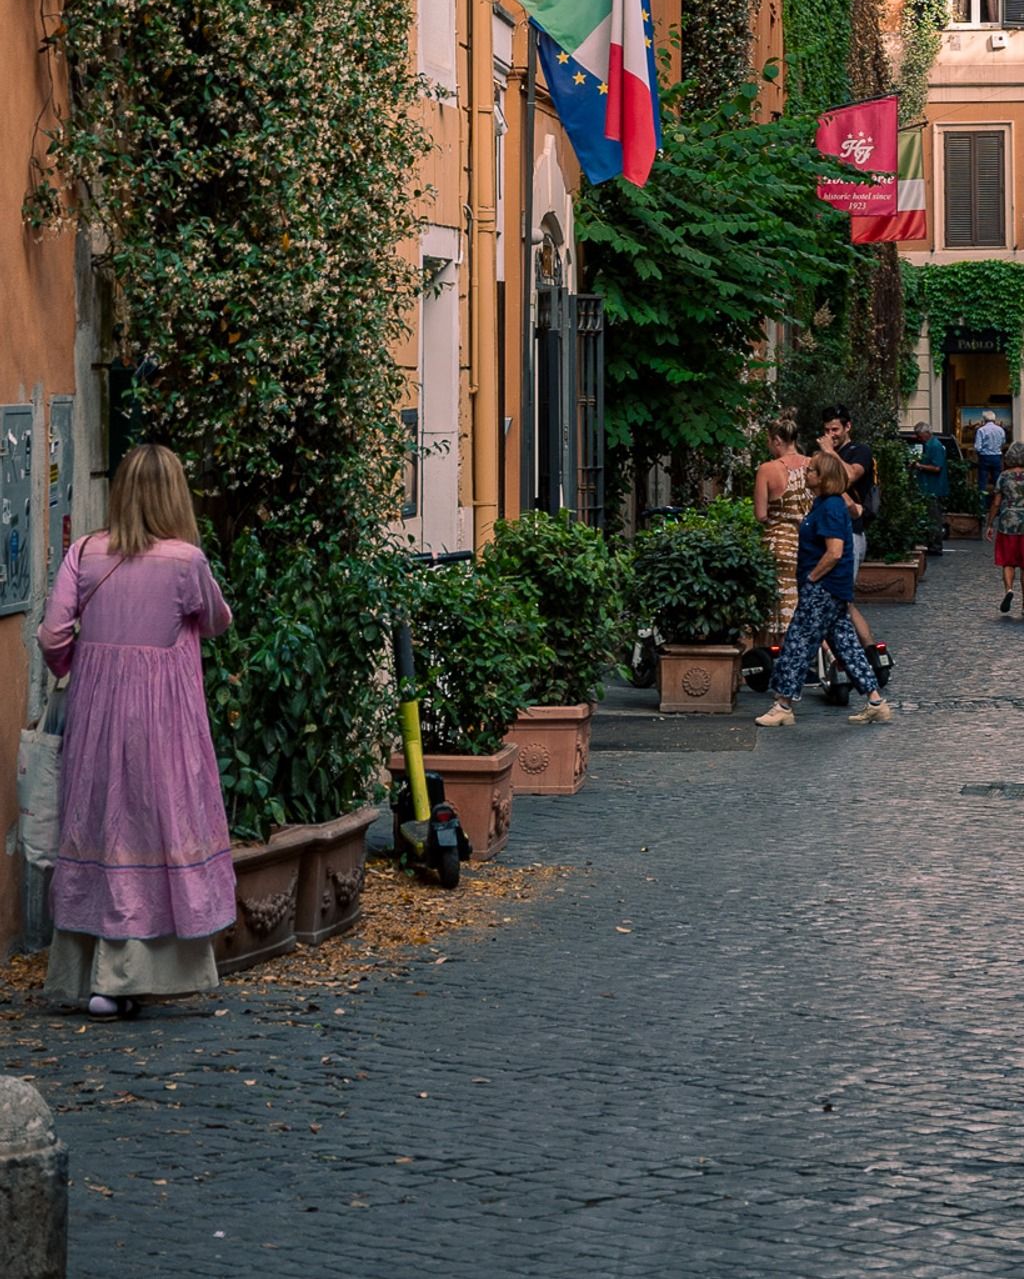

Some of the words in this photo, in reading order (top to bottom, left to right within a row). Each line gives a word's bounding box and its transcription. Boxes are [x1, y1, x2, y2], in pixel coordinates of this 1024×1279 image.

[823, 192, 851, 200] historic
[852, 192, 871, 200] hotel
[872, 192, 892, 200] since
[848, 201, 867, 210] 1923
